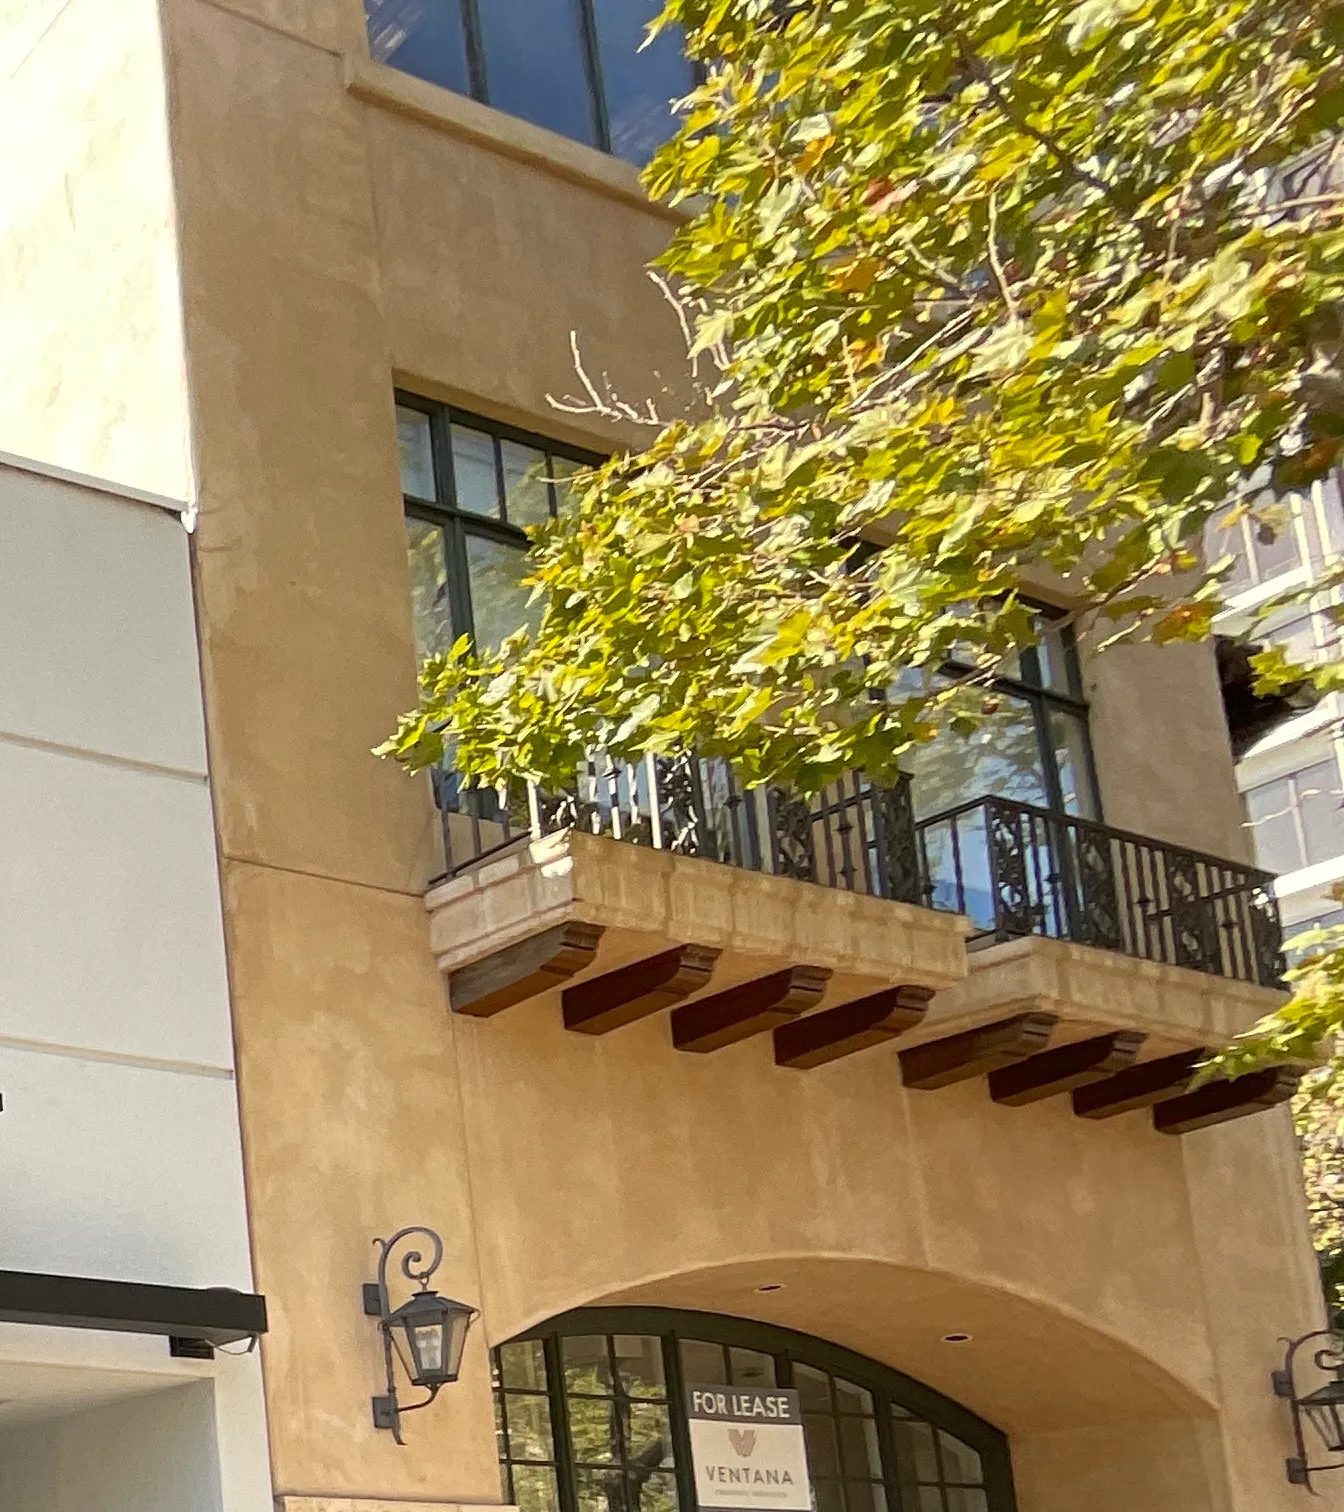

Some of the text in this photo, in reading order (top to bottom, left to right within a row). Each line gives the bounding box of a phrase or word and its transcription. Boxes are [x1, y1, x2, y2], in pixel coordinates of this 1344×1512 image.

[691, 1390, 791, 1419] FOR LEASE
[705, 1465, 795, 1487] VENTANA
